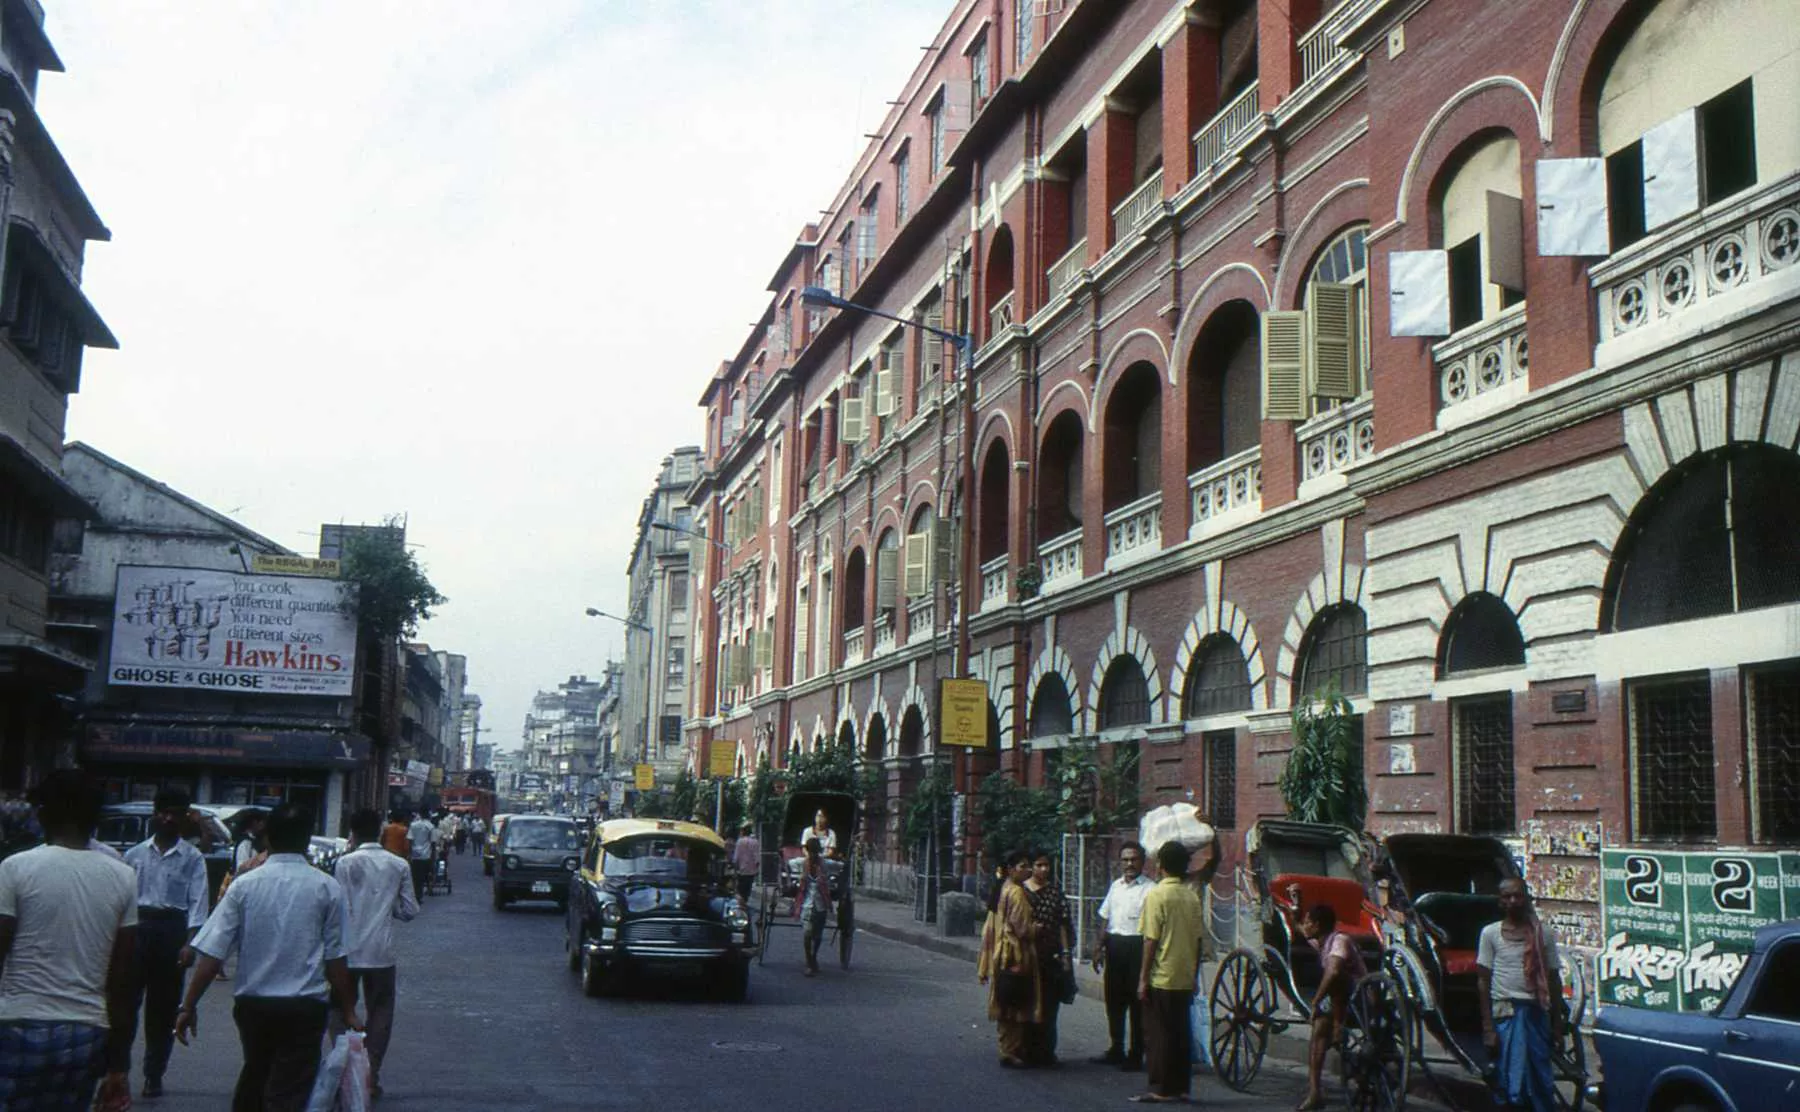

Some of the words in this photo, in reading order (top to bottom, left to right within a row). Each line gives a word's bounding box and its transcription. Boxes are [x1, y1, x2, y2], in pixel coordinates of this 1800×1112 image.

[312, 559, 337, 569] BAR
[231, 577, 255, 593] You
[259, 581, 293, 595] cook
[229, 594, 283, 610] different
[231, 608, 254, 624] You
[258, 614, 293, 626] need
[228, 626, 283, 642] different
[290, 628, 323, 643] sizes
[224, 640, 342, 672] Hawkins
[114, 667, 179, 684] GHOSE
[184, 672, 193, 682] &
[198, 672, 264, 689] GHOSE
[1625, 856, 1662, 908] 2
[1664, 872, 1682, 885] WEEK
[1711, 857, 1755, 913] 2
[1757, 874, 1779, 889] WEEK
[1601, 931, 1685, 988] FAREB
